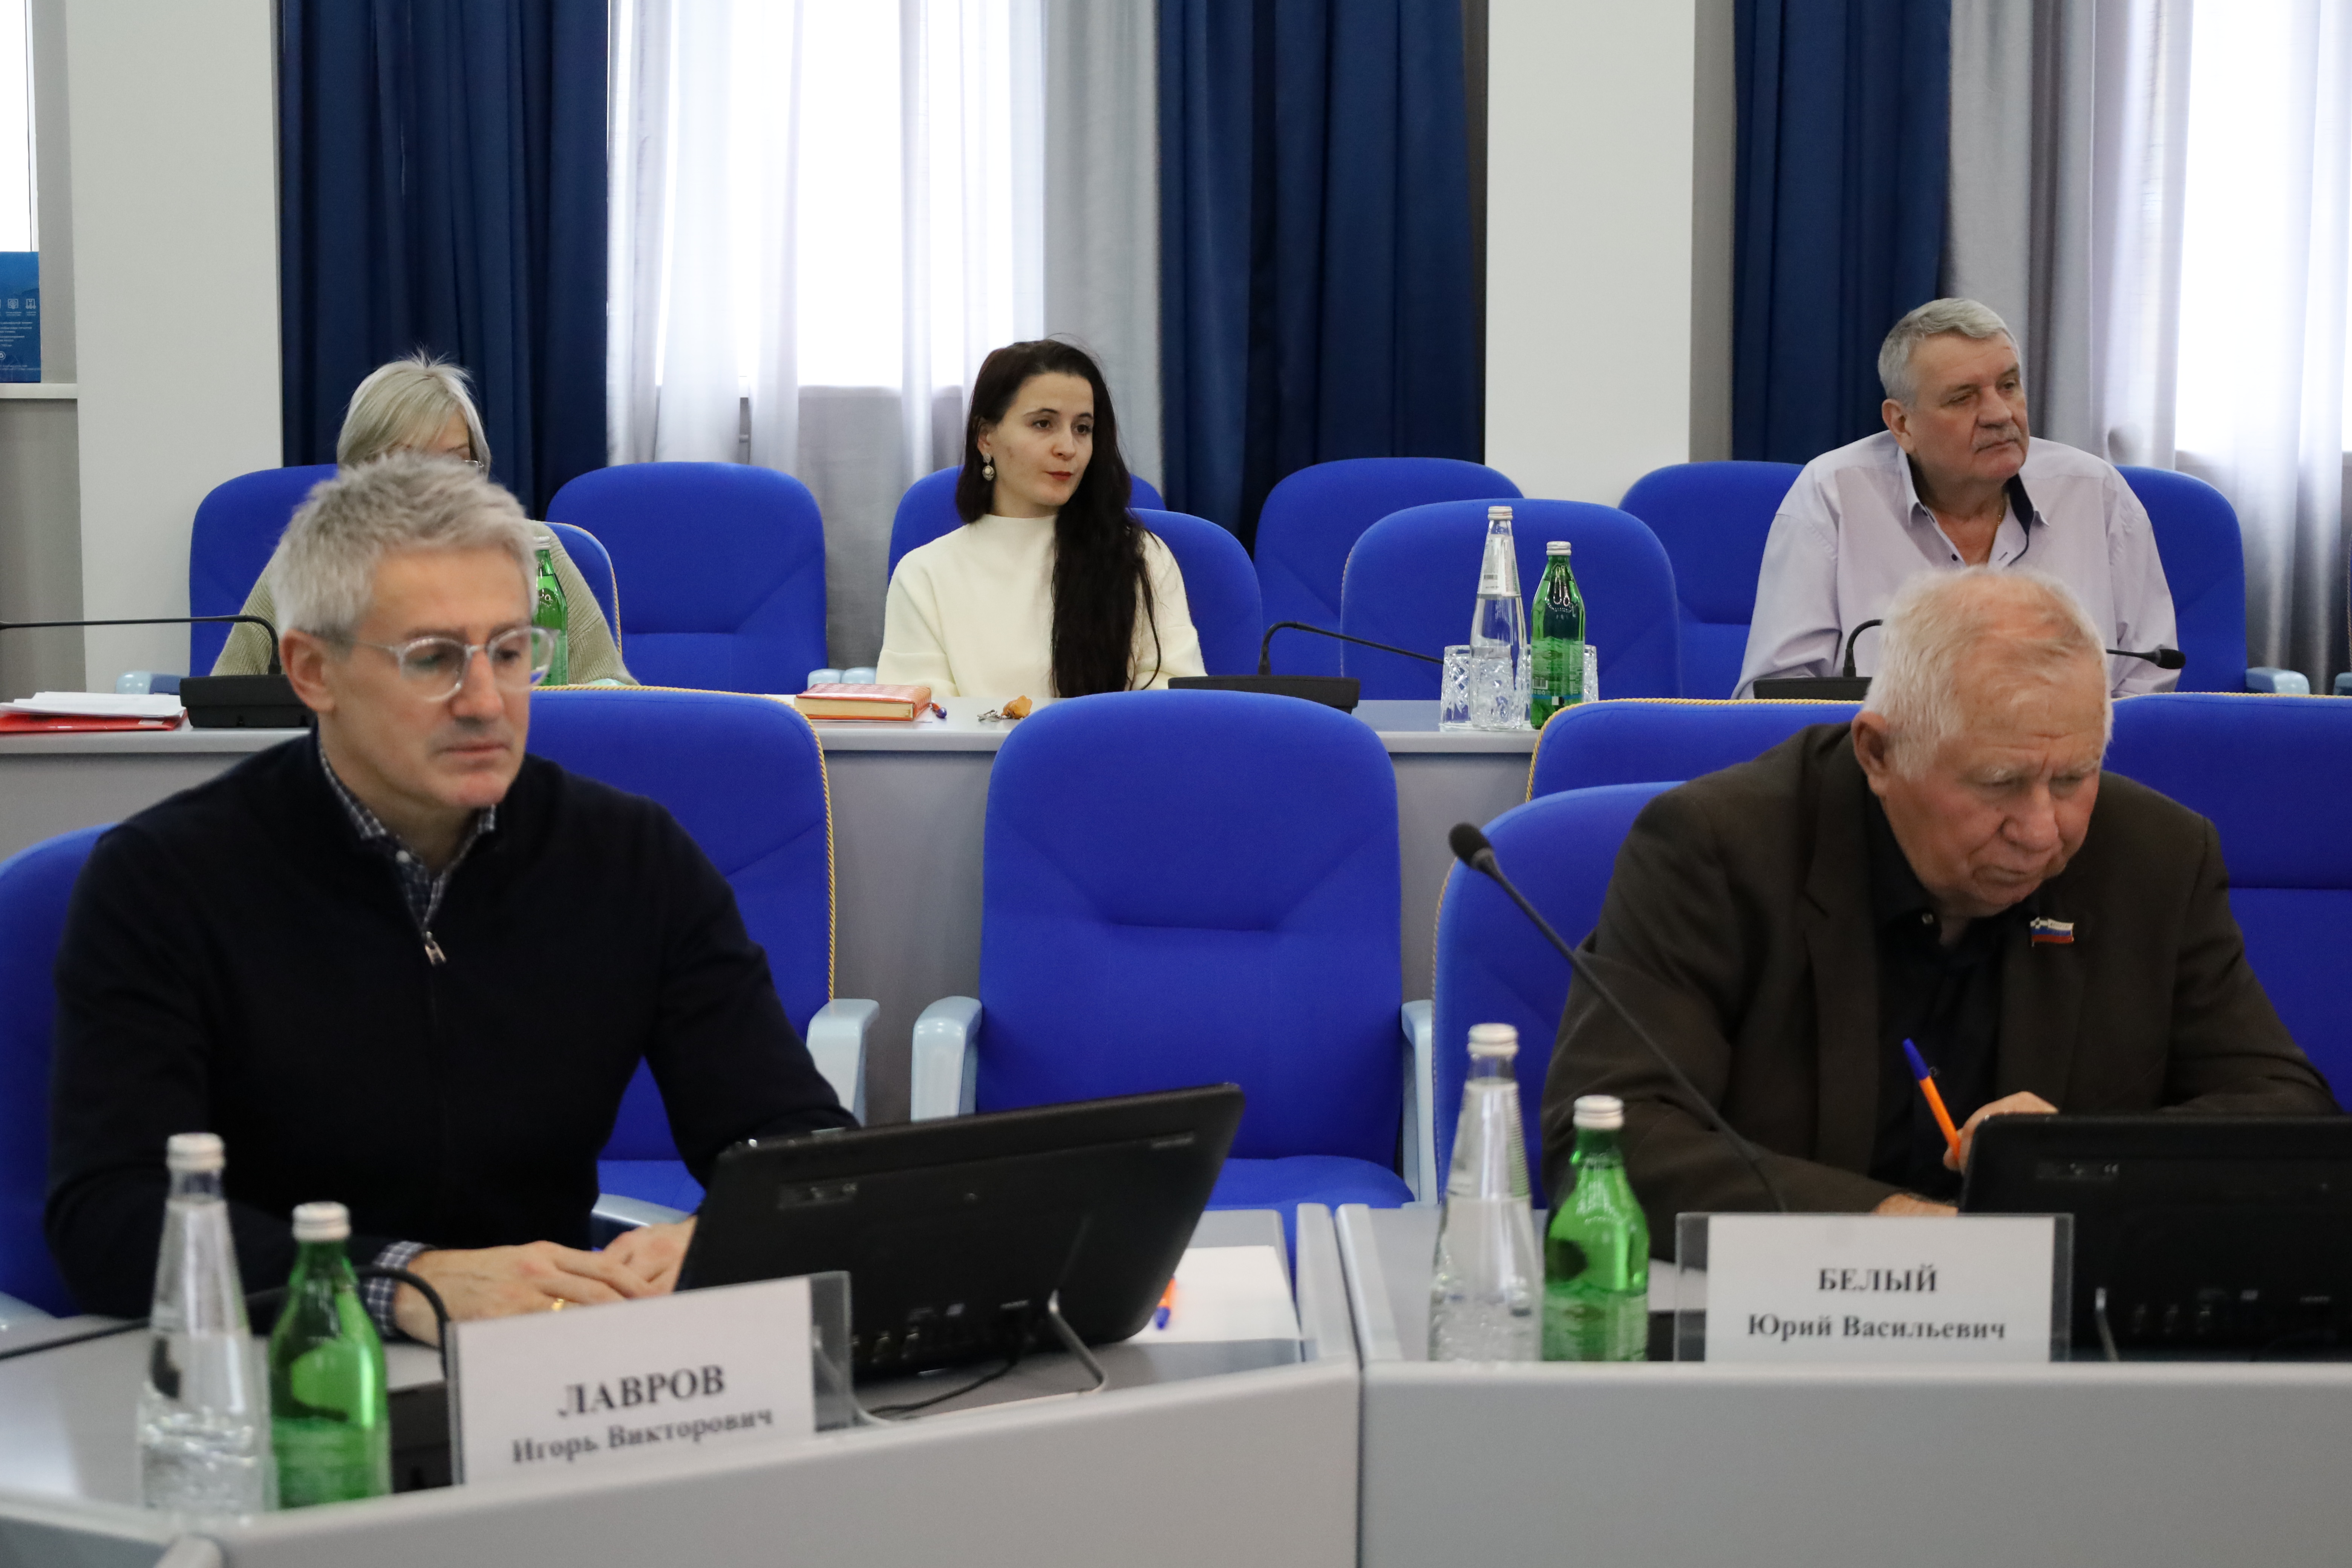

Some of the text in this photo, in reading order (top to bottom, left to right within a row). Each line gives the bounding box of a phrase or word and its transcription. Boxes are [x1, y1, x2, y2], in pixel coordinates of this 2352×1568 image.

[1818, 1264, 1937, 1292] БЕЛЫЙ
[1749, 1314, 2005, 1342] Юрий Васильевич
[558, 1365, 726, 1417] ЛАВРОВ
[512, 1408, 773, 1463] Игорь Викторович
